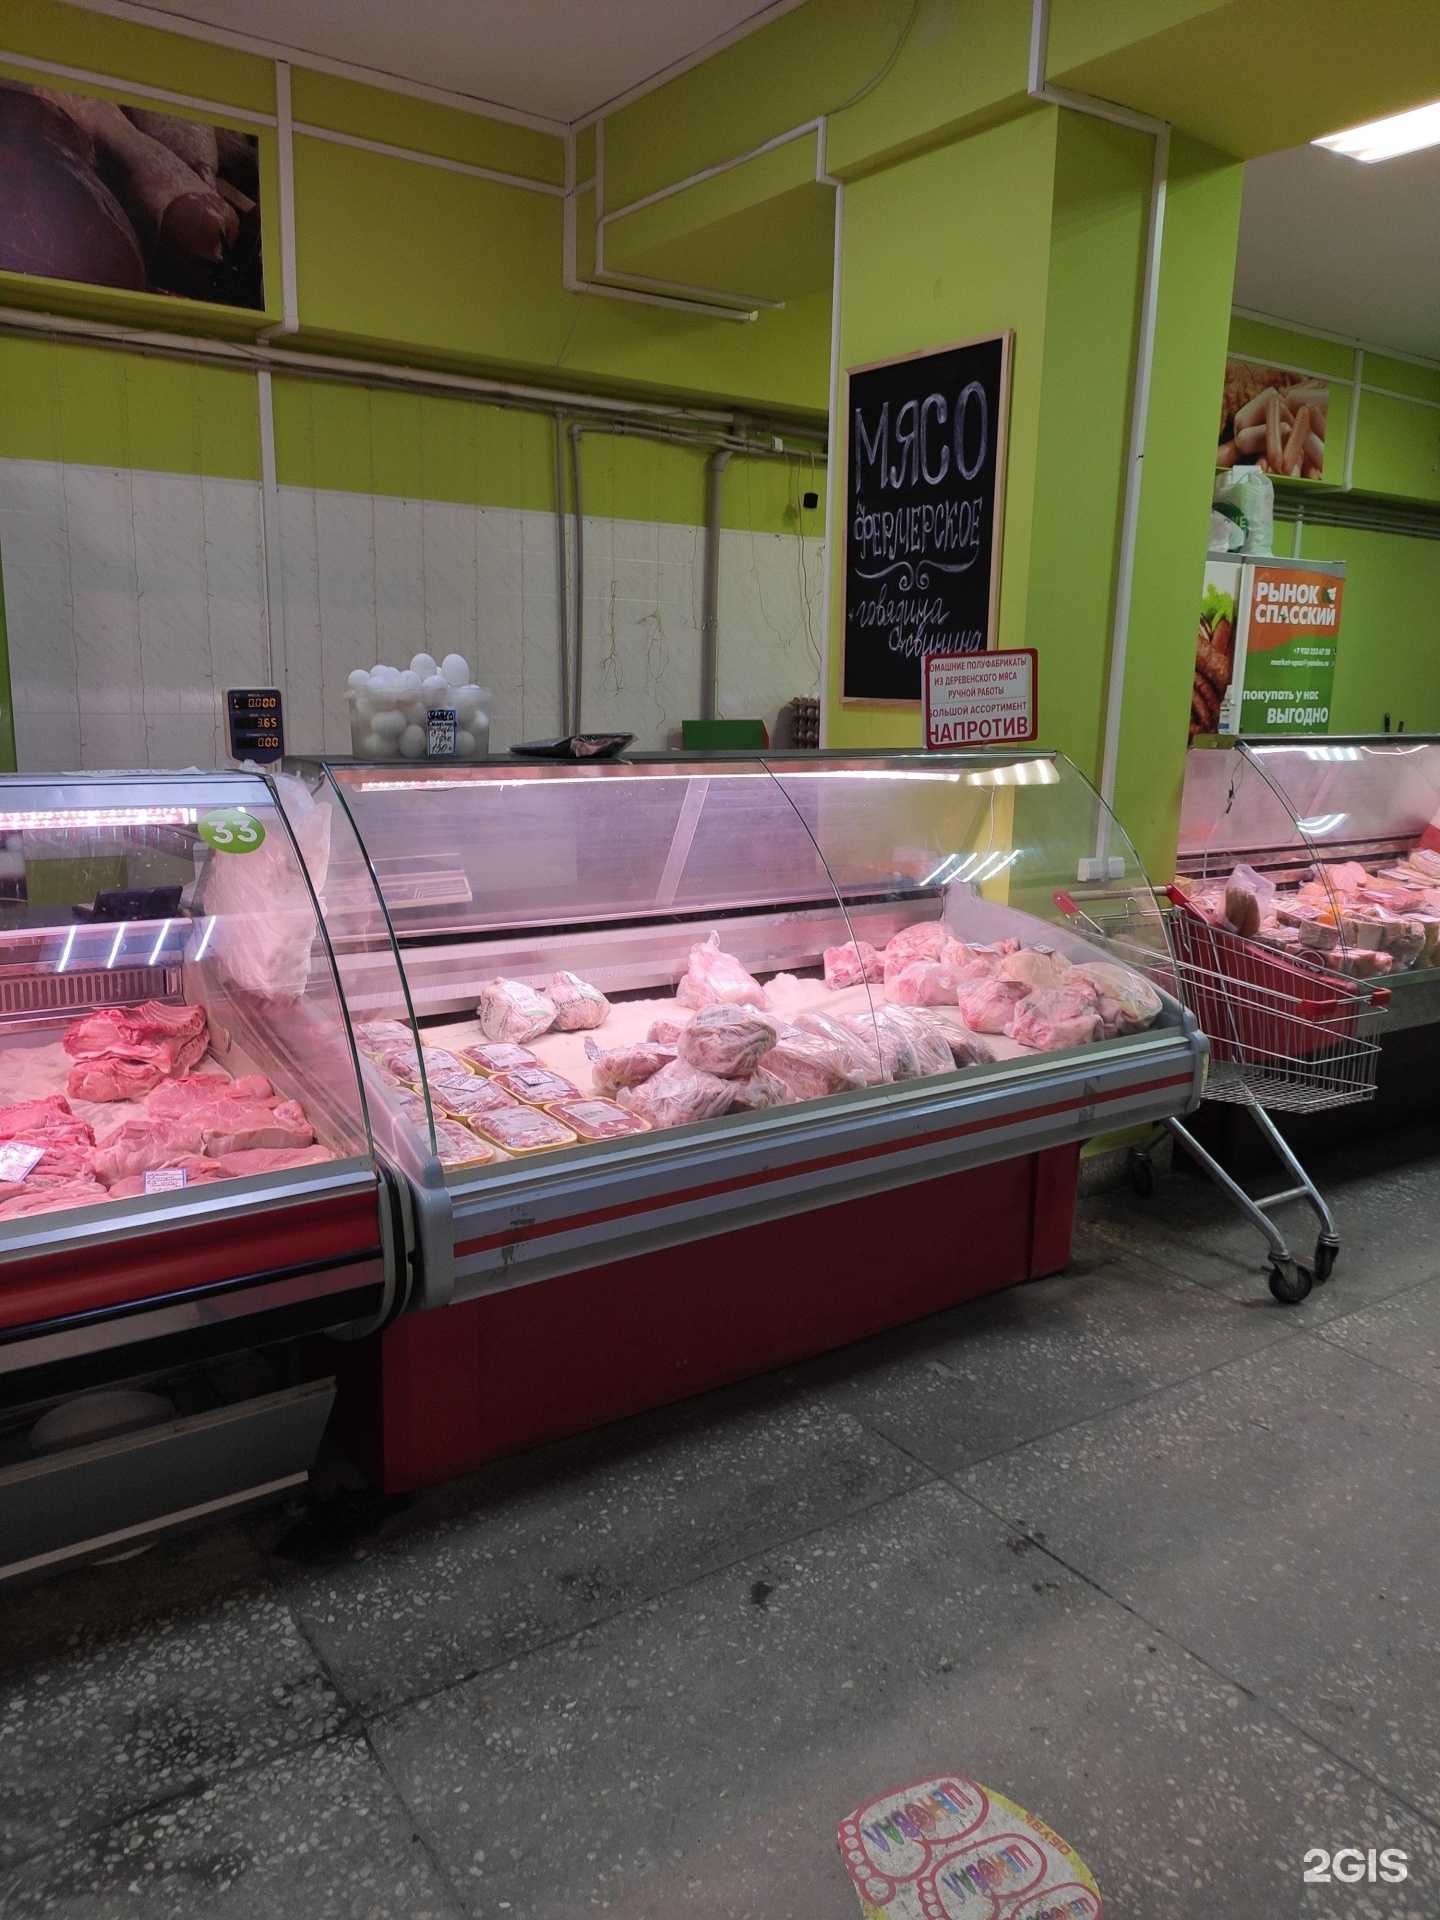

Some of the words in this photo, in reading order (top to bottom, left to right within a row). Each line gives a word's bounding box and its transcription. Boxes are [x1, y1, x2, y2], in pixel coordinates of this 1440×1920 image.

[855, 381, 988, 494] МЯСО
[1256, 582, 1320, 604] РЫНОК
[1255, 603, 1336, 626] СПАССКИЙ
[929, 662, 967, 673] ОМАШНИЕ
[966, 658, 1027, 670] ПОЛУФАБРИКАТЫ
[934, 678, 944, 686] ИЗ
[945, 673, 997, 686] ДЕРЕВЕНСКОГО
[998, 671, 1017, 681] МЯСА
[948, 688, 976, 699] РУЧНОЙ
[977, 687, 1005, 696] РАБОТЫ
[1243, 690, 1295, 703] покупать
[1295, 690, 1303, 703] у
[1303, 690, 1319, 700] нас
[970, 701, 1027, 714] АССОРТИМЕНТ
[1266, 707, 1329, 726] ВЫГОДНО
[208, 819, 258, 844] 33
